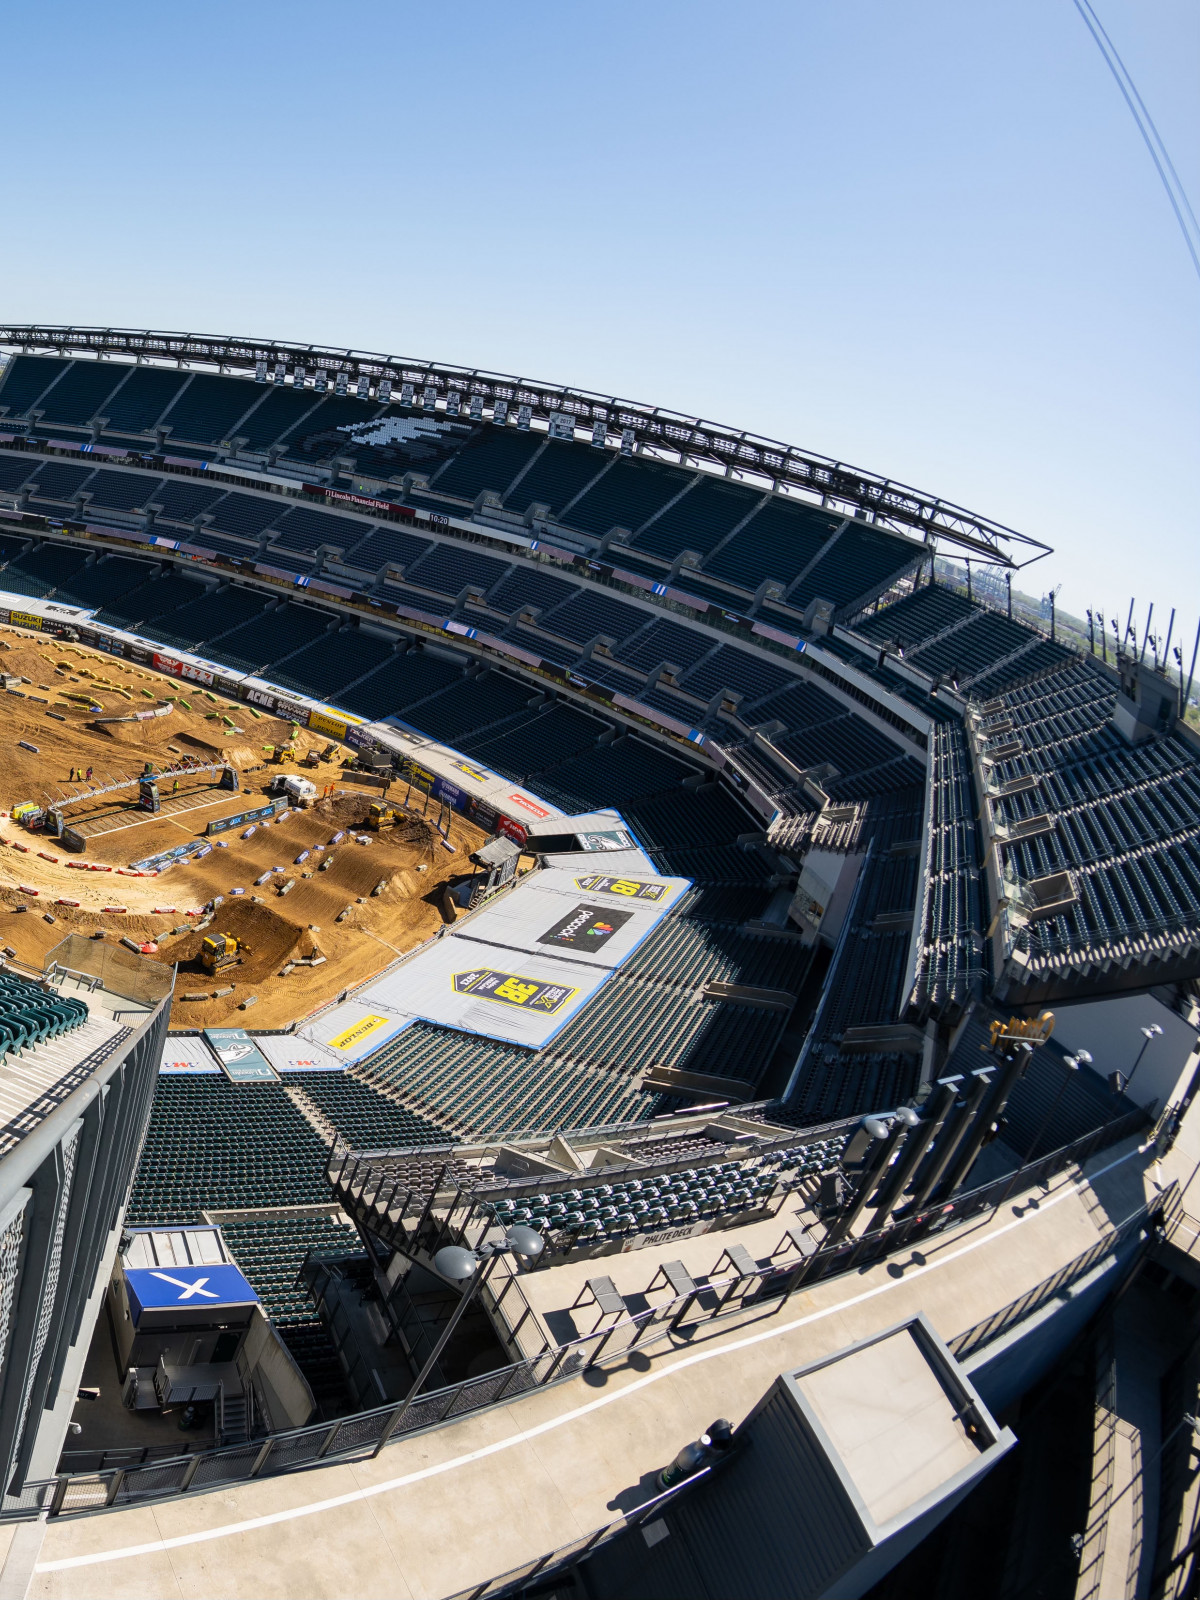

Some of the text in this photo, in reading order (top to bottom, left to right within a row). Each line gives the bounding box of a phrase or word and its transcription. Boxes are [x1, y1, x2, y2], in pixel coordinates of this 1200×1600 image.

[331, 491, 390, 511] Lincoln Financial Field
[430, 514, 448, 525] 10:20
[11, 619, 41, 631] SUZUKI
[12, 612, 41, 624] SUZUKI
[246, 689, 275, 709] ACME
[316, 723, 343, 738] DUNLOP
[318, 714, 345, 729] DUNLOP
[610, 879, 641, 896] 18
[557, 908, 595, 938] peacock
[493, 976, 540, 1005] 38
[339, 1021, 374, 1048] DUNLOP
[641, 1230, 672, 1246] PHLITE
[672, 1226, 695, 1239] DECK
